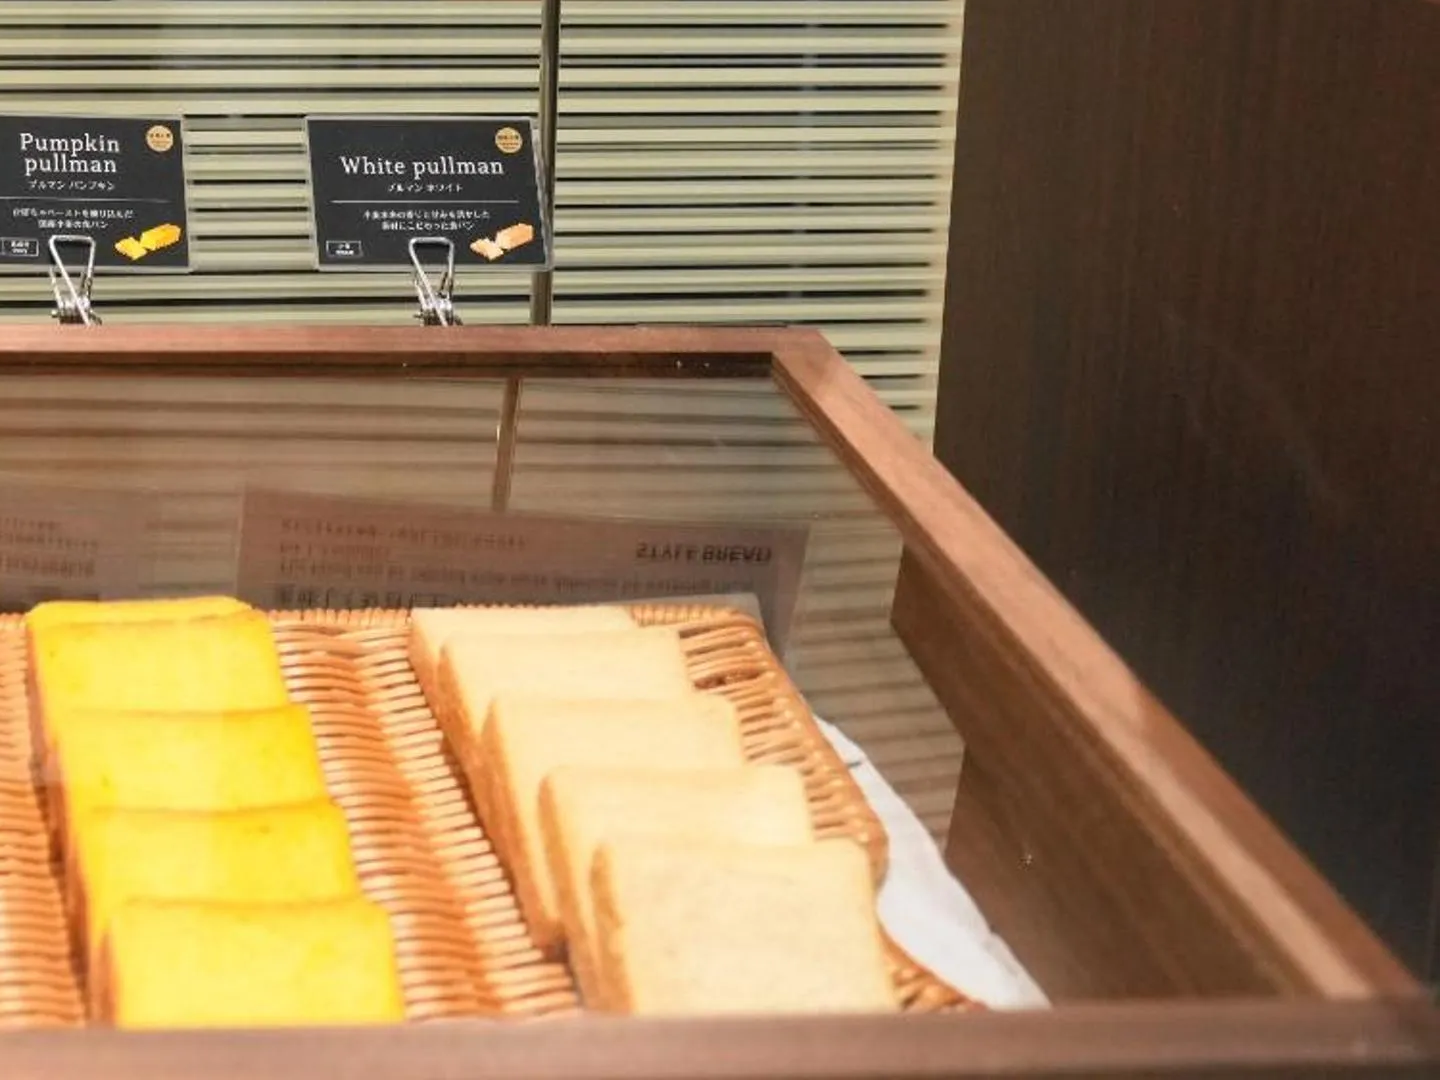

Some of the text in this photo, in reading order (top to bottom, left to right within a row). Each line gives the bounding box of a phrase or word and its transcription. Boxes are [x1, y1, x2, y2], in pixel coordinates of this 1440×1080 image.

[20, 132, 121, 157] Pumpkin
[24, 152, 117, 176] pullman
[338, 155, 505, 180] White pullman
